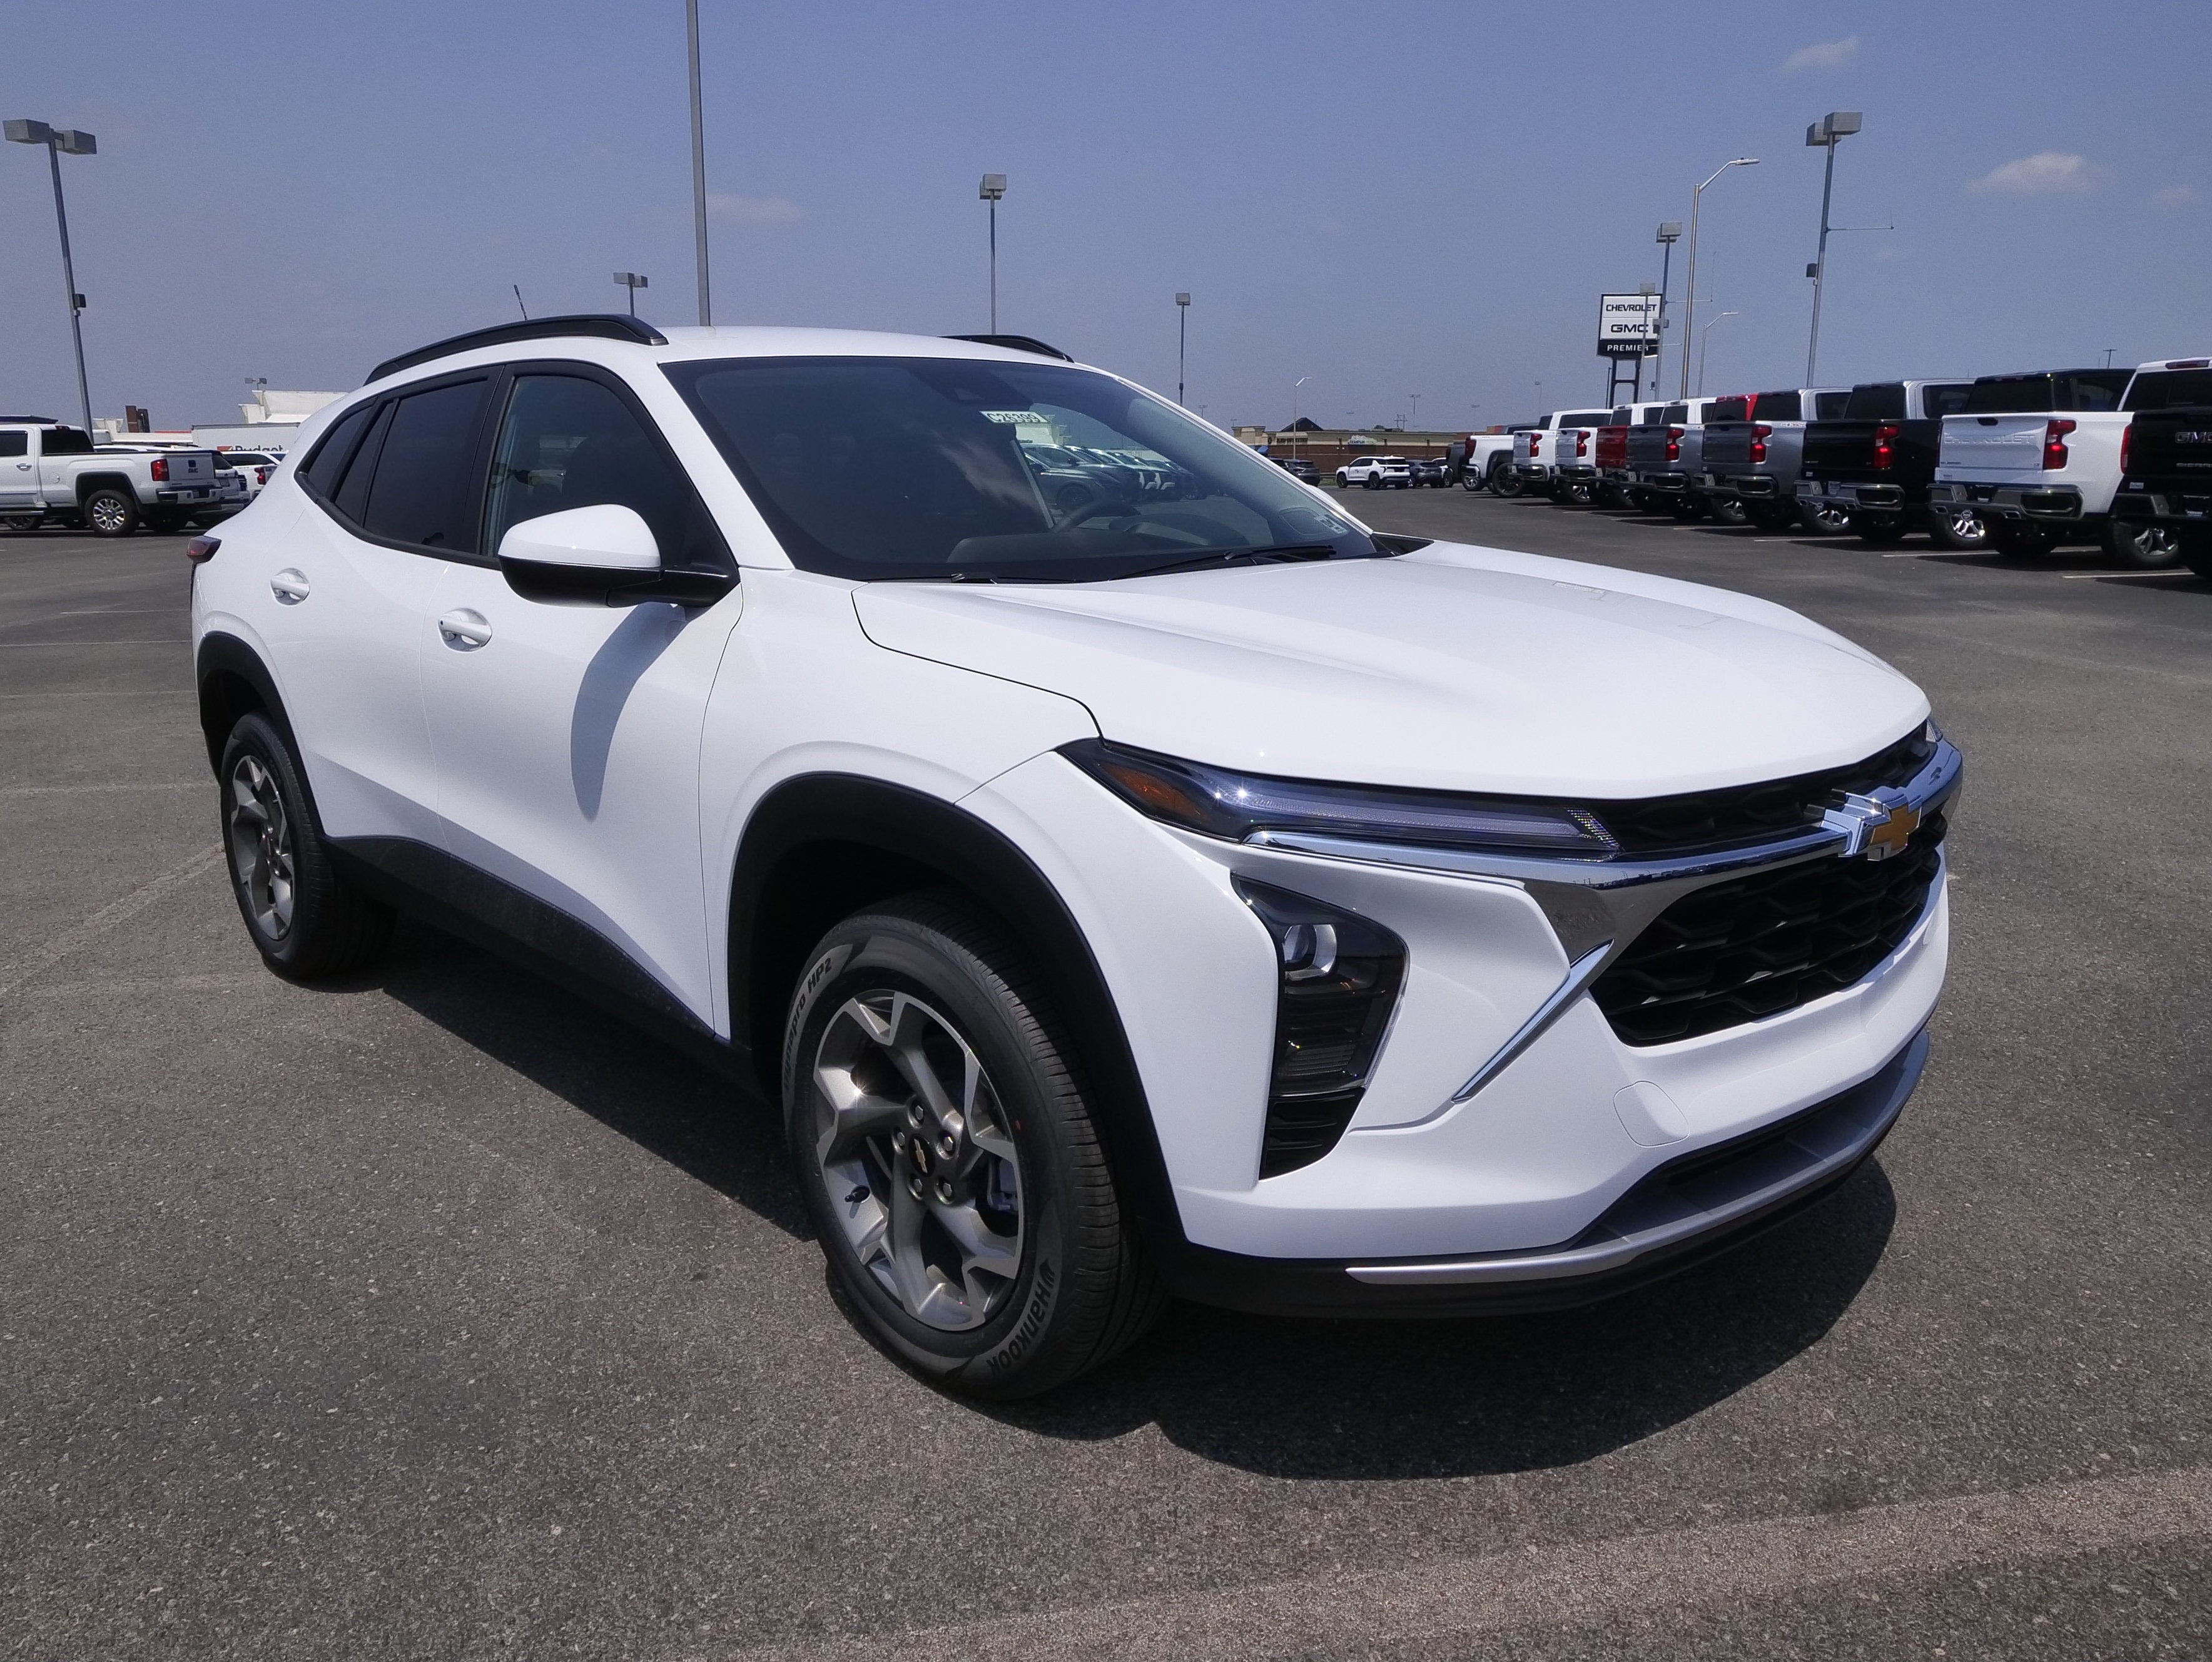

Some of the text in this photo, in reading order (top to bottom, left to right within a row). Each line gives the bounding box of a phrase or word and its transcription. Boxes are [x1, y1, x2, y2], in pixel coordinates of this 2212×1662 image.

[1611, 324, 1649, 333] GMC
[987, 413, 1040, 422] C26399
[807, 957, 833, 994] HP2
